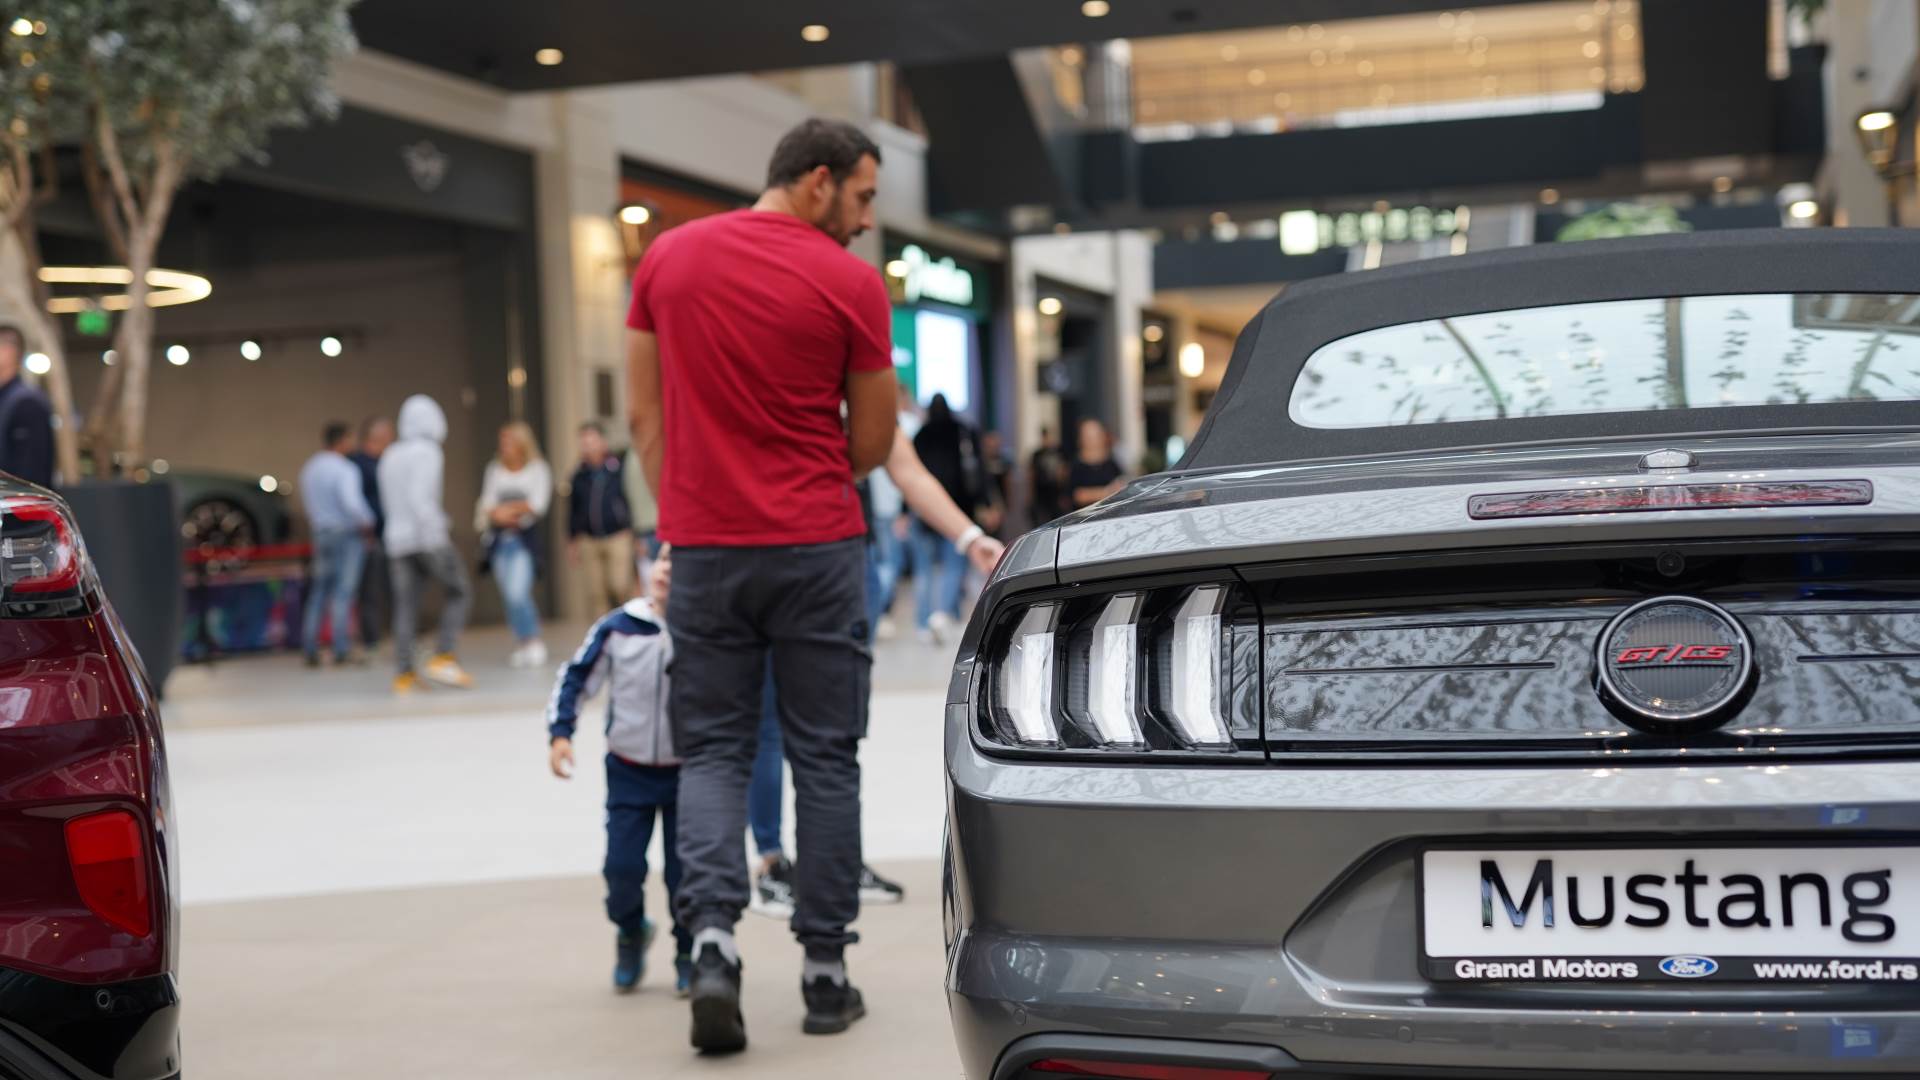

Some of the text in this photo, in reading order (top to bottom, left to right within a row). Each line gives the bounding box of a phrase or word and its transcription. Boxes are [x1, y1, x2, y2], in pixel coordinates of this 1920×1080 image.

[1617, 643, 1733, 663] GT/CS
[1480, 858, 1896, 943] Mustang
[1455, 959, 1639, 979] Grand Motors
[1665, 957, 1709, 975] Ford
[1753, 960, 1919, 980] www.ford.rs
